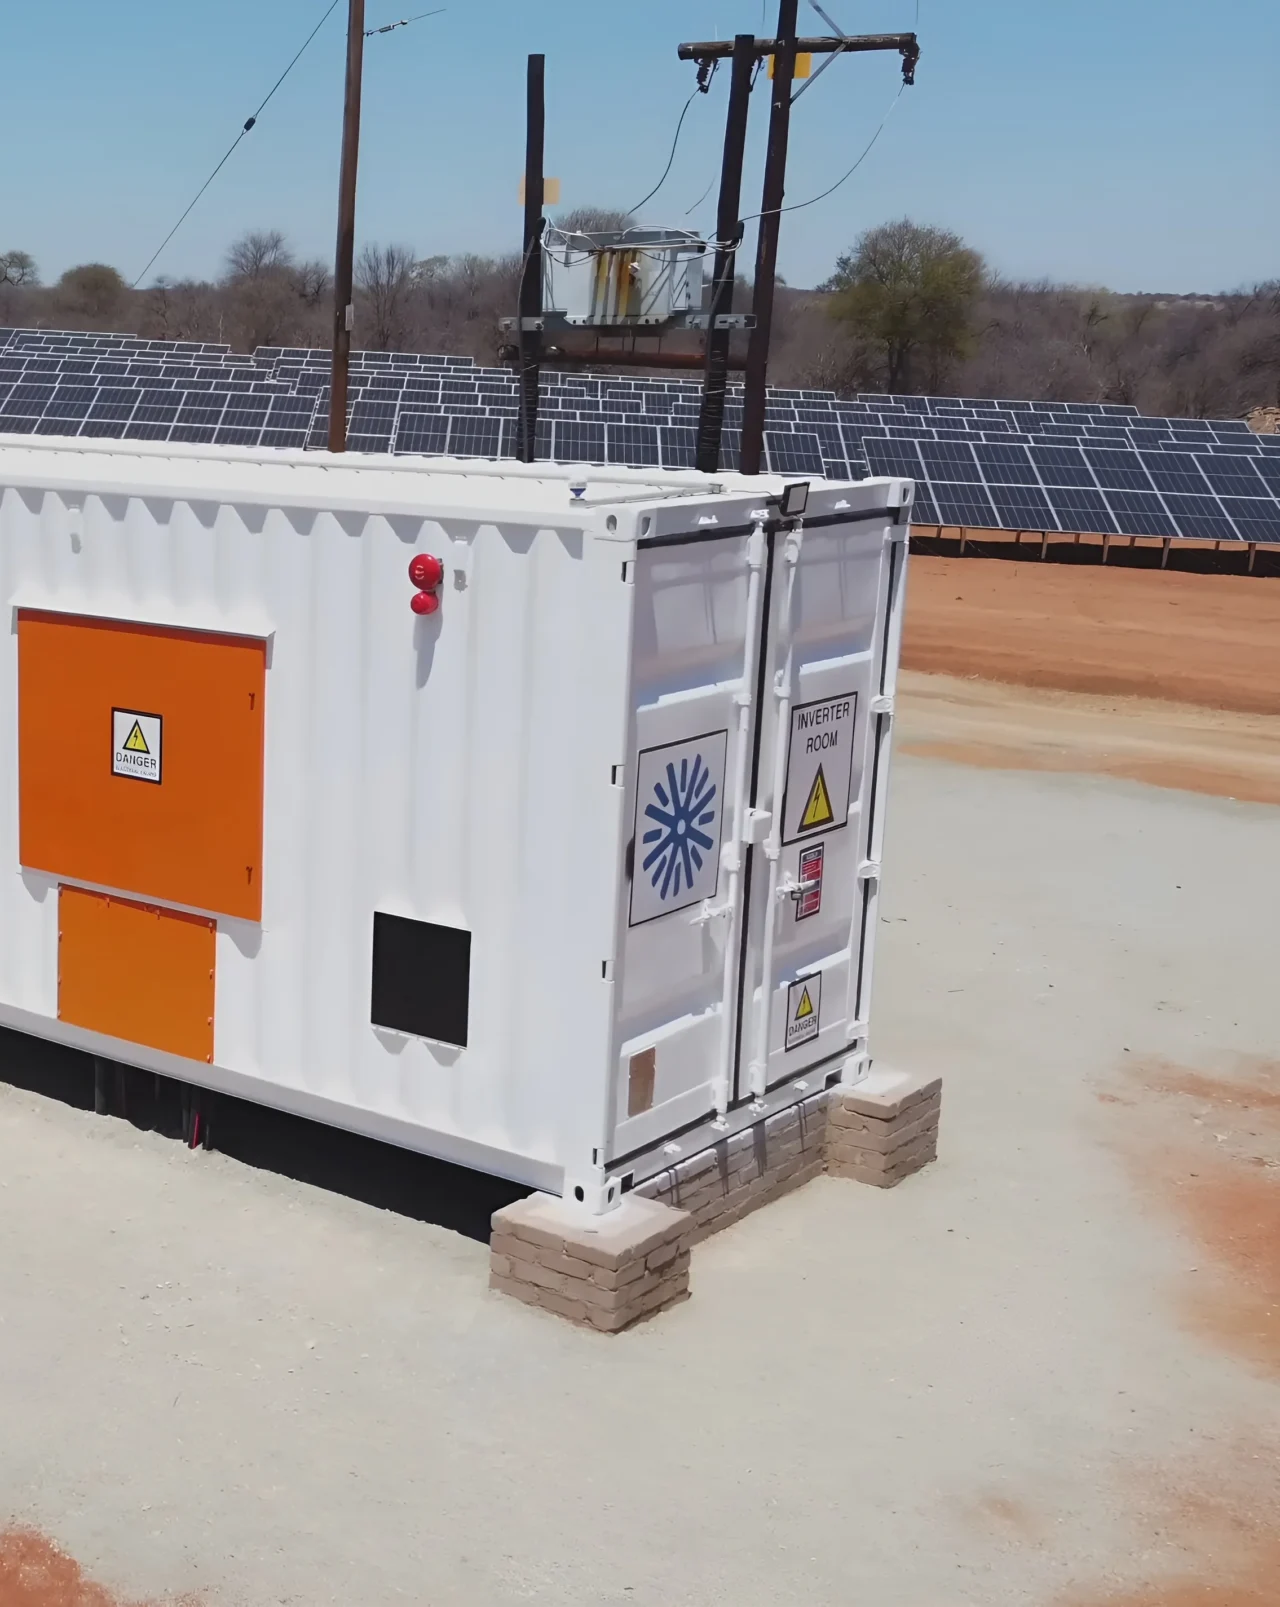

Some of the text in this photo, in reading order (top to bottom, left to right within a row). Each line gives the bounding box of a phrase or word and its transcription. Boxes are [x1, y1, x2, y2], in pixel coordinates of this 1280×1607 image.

[797, 702, 850, 731] INVERTER
[805, 730, 838, 754] ROOM
[116, 752, 157, 770] DANGER
[789, 1015, 817, 1037] DANGER
